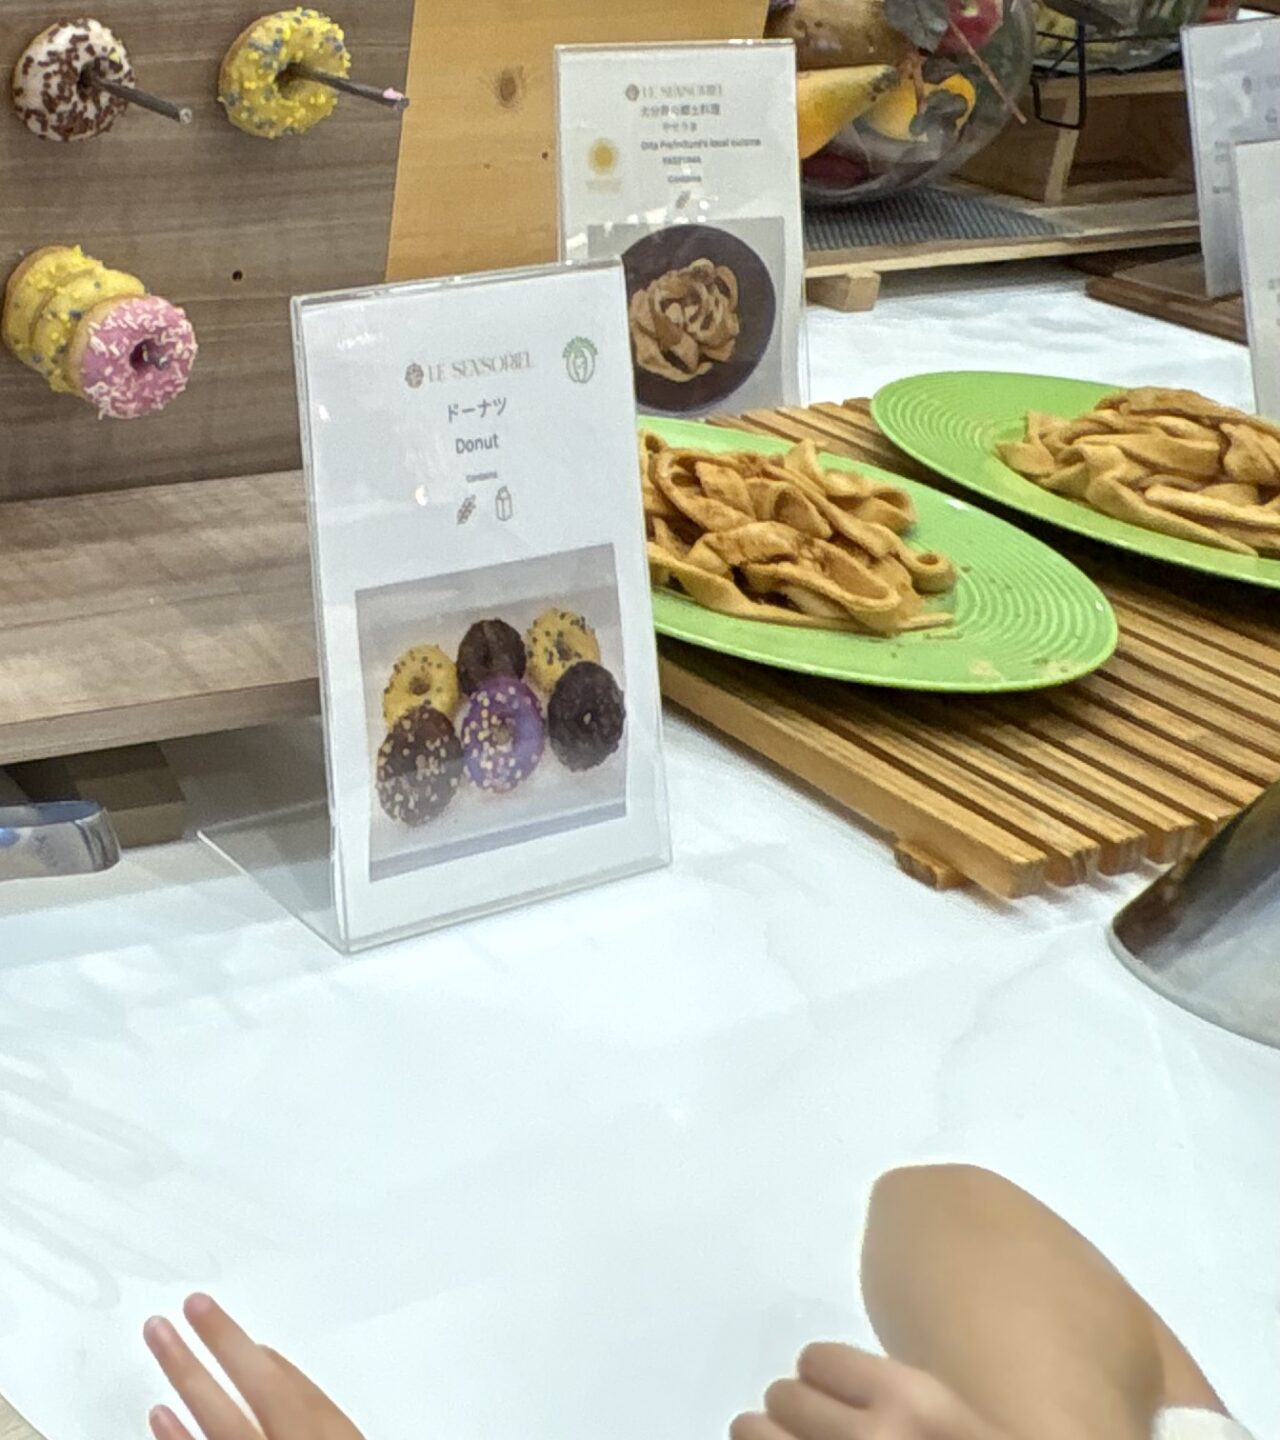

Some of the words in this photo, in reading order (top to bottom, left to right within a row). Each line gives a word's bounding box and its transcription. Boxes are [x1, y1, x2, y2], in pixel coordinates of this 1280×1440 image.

[447, 397, 507, 423] ドーナツ
[455, 433, 499, 454] Donut
